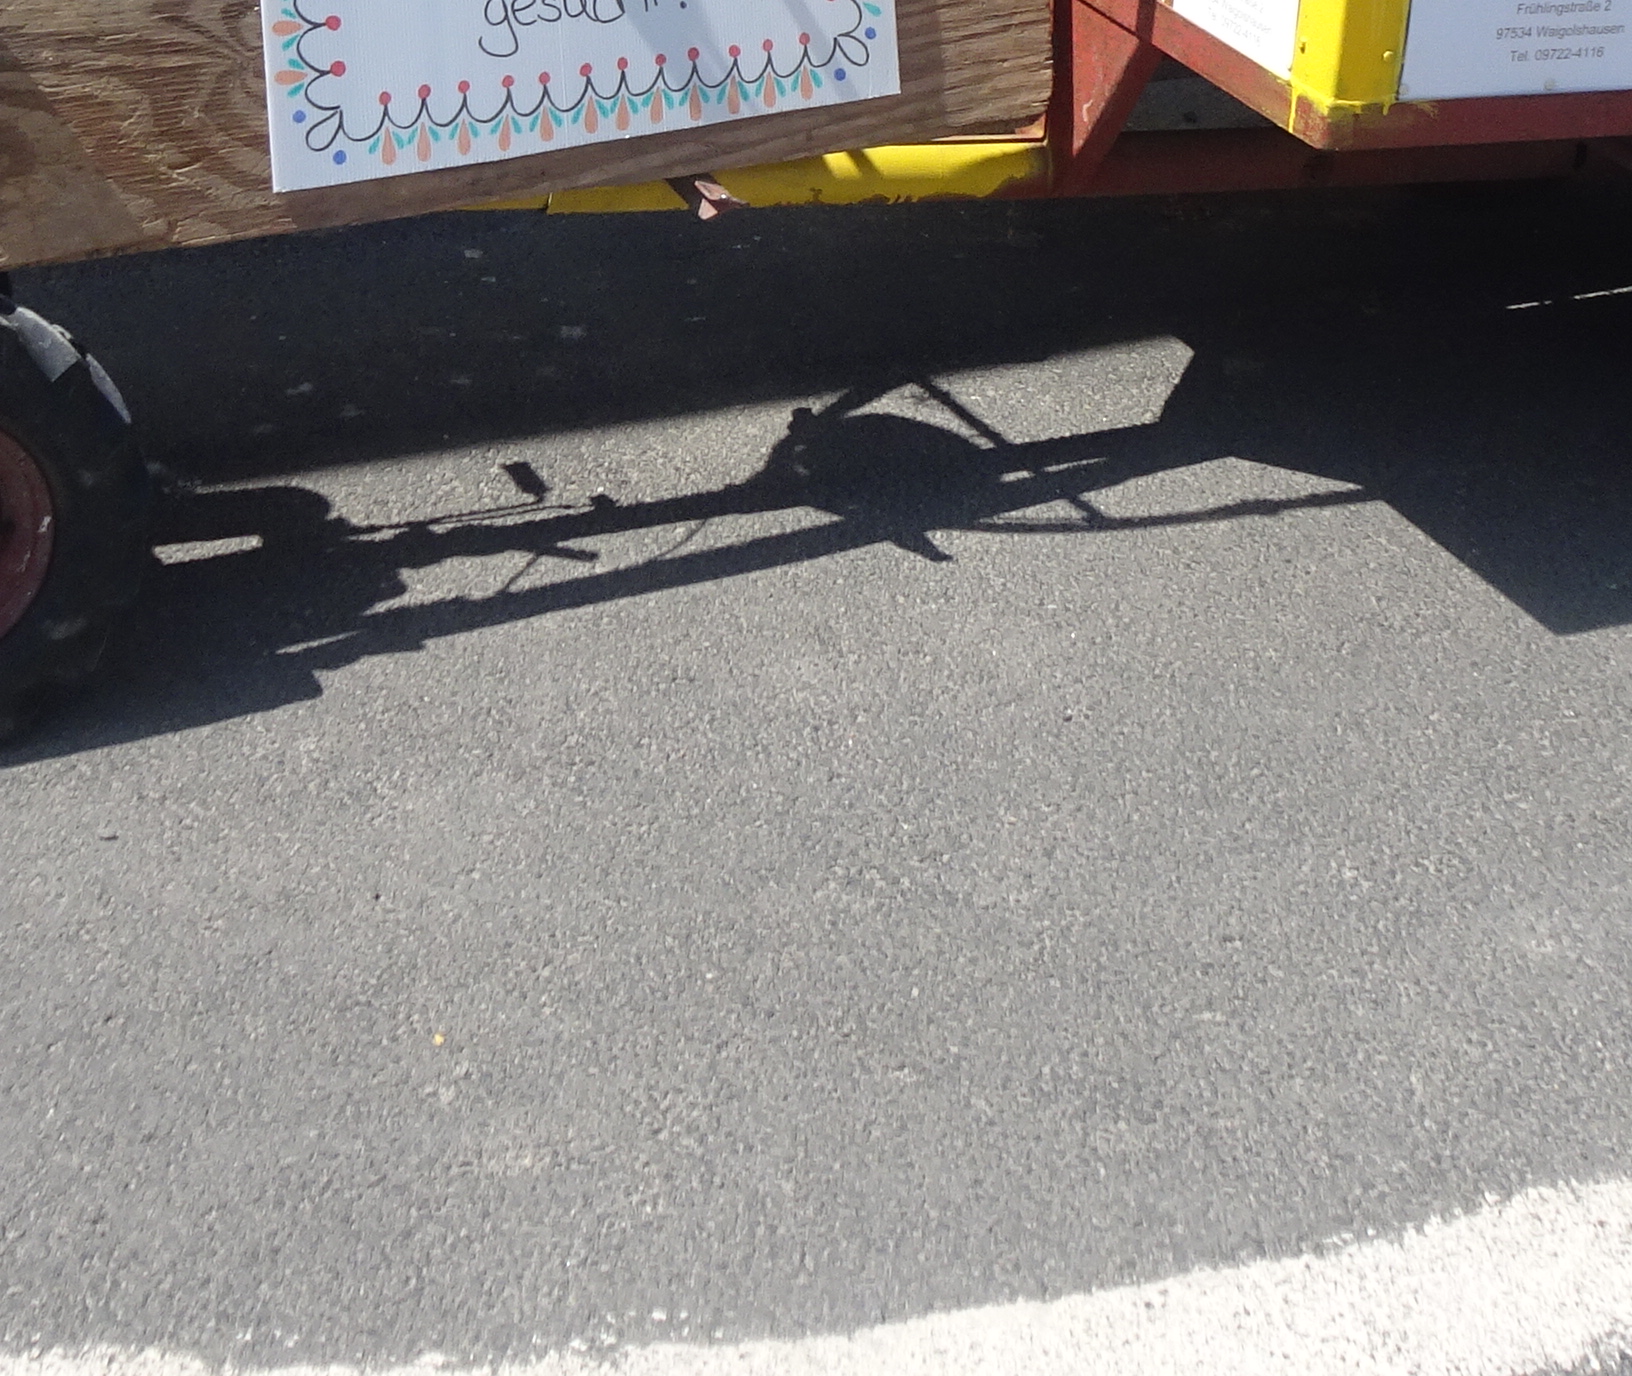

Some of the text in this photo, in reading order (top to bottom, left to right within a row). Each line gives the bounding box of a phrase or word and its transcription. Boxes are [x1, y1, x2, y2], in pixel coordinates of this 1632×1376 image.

[1604, 0, 1612, 12] 2
[1496, 25, 1625, 40] 97534 Waigolshausen
[1534, 46, 1605, 61] 09722-4116
